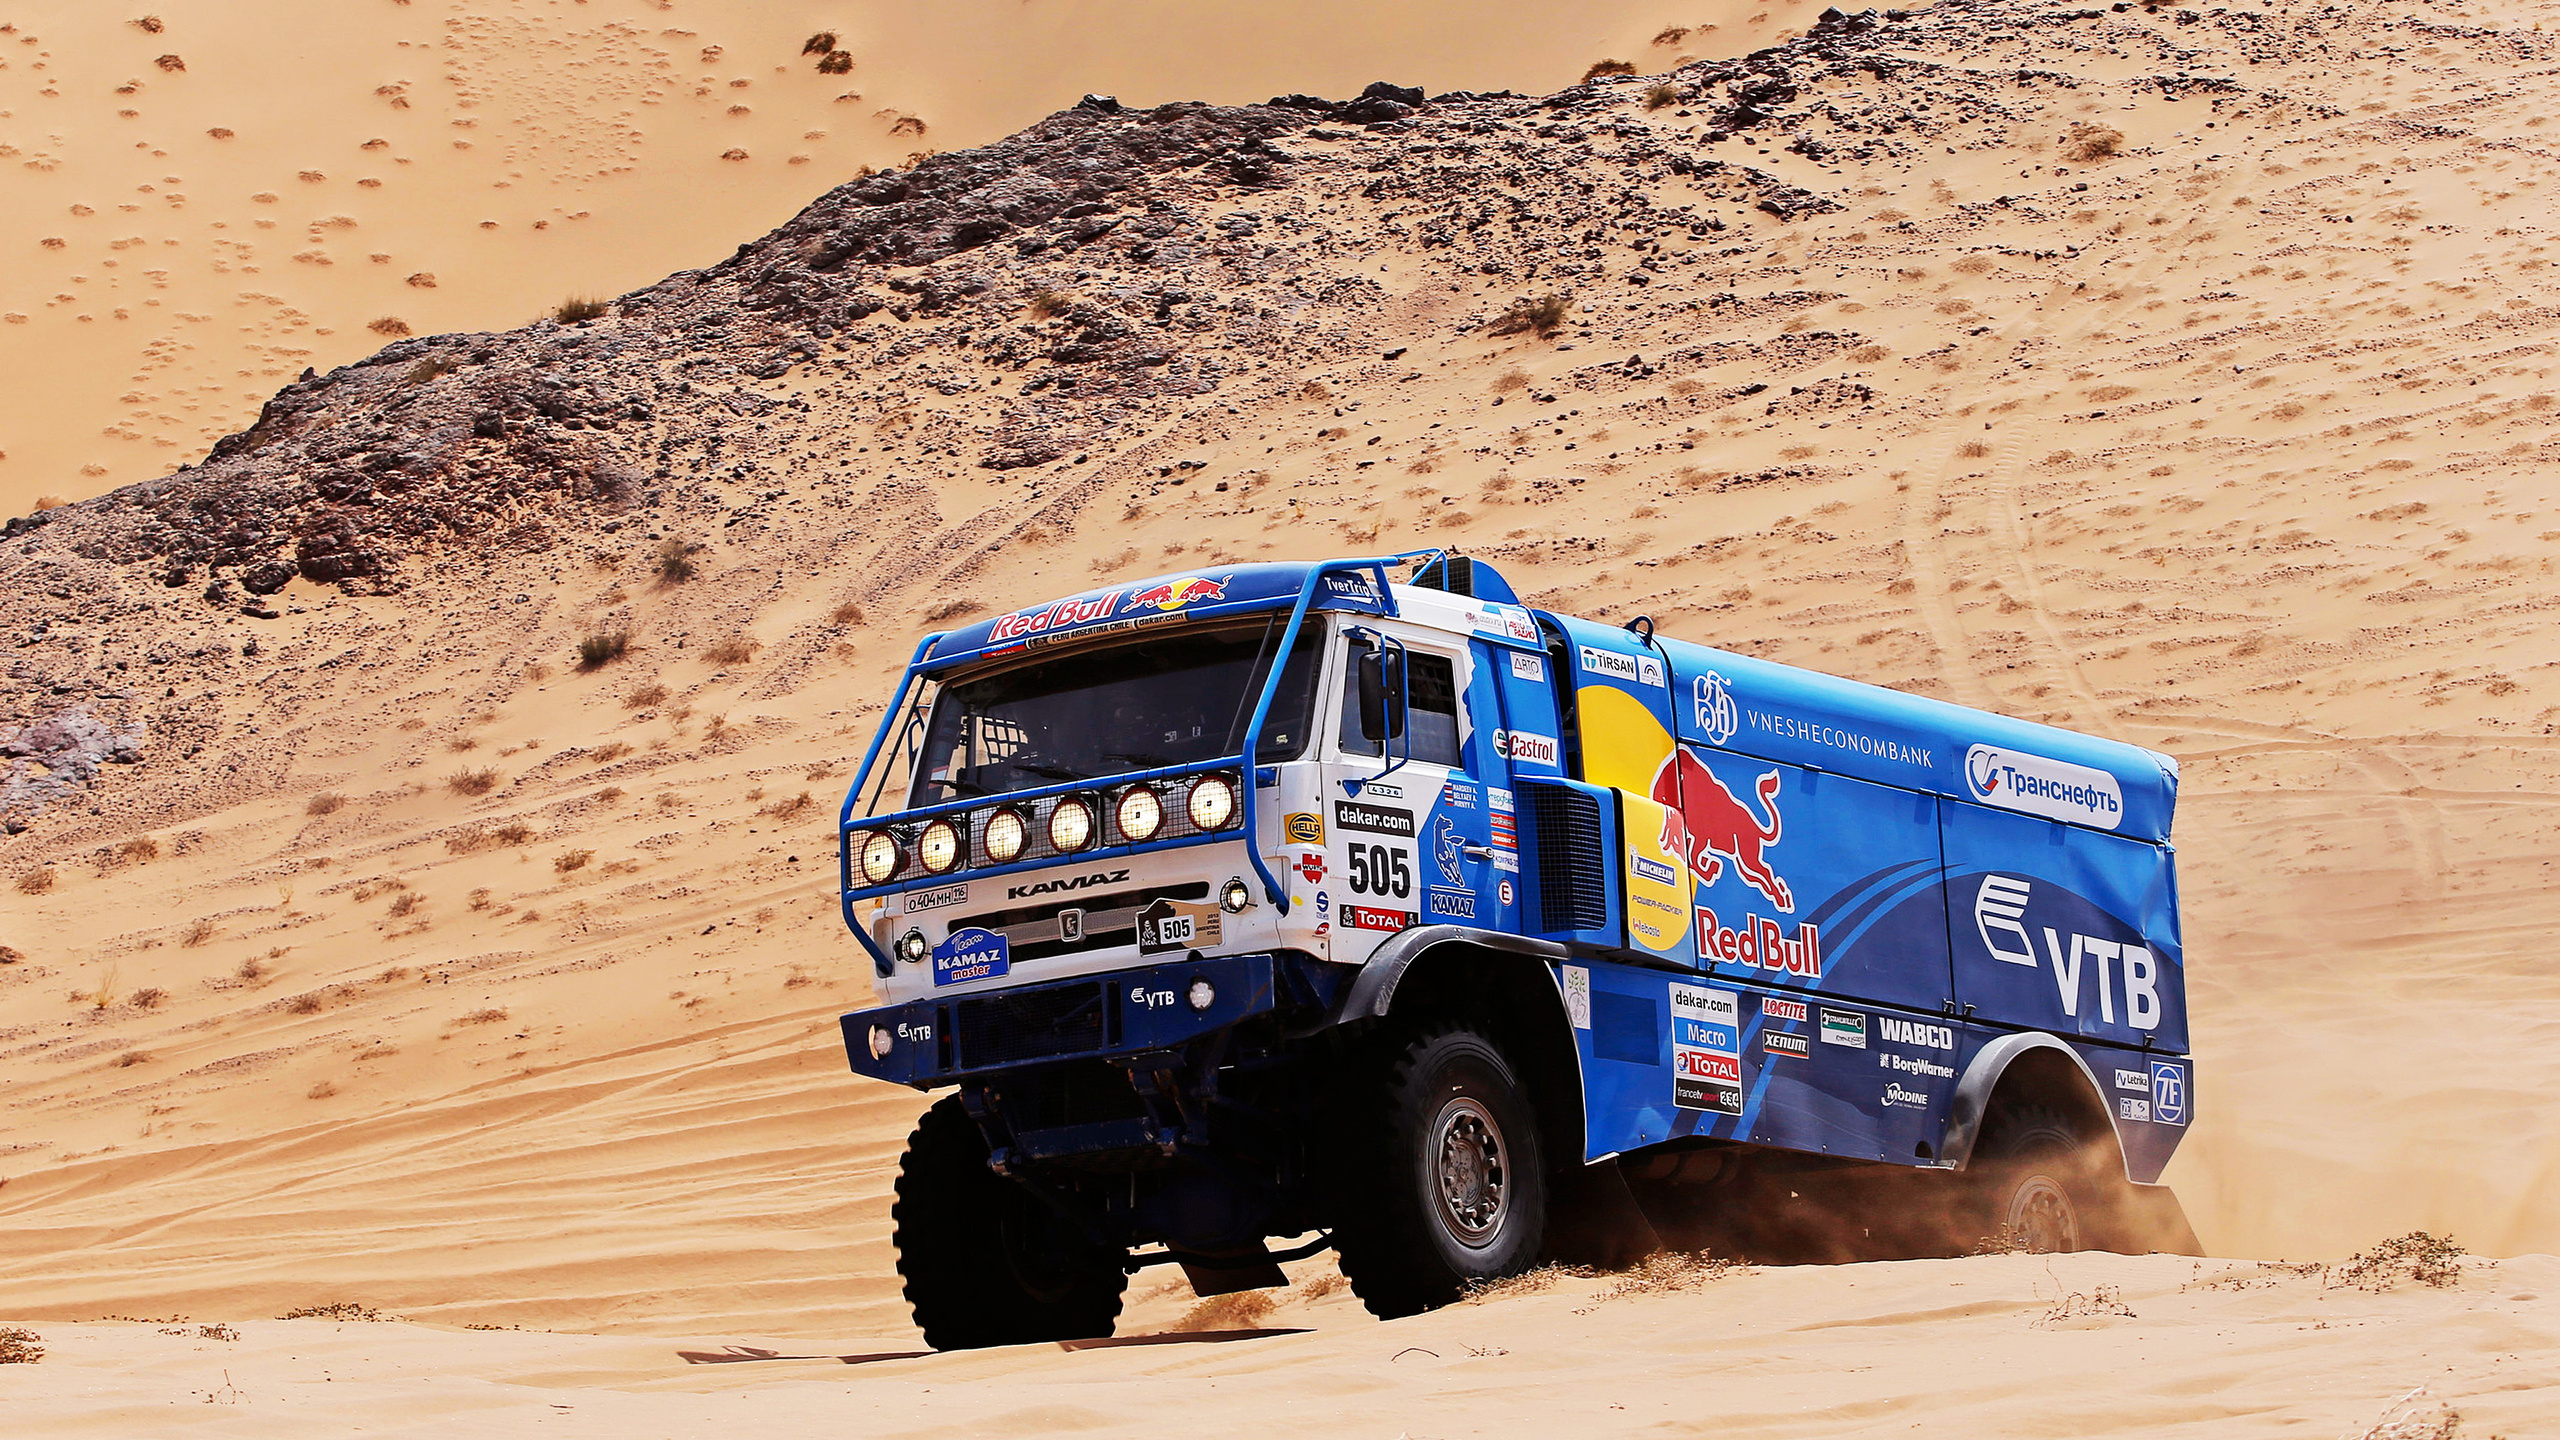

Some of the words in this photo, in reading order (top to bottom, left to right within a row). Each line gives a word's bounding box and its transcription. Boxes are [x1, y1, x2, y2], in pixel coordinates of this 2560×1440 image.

[1324, 577, 1370, 597] TverTrip
[987, 603, 1059, 643] Red
[1051, 589, 1125, 628] Bull
[1139, 613, 1184, 626] dakar.com
[1510, 734, 1554, 762] Castrol
[1747, 709, 1933, 769] VNESHECONOMBANK
[2002, 765, 2118, 813] Транснефть
[1292, 822, 1320, 834] HELLA
[1339, 806, 1410, 830] dakar.com
[1348, 842, 1410, 899] 505
[1640, 861, 1674, 880] MICHELIN
[1007, 869, 1130, 900] KAMAZ
[1431, 893, 1475, 918] KAMAZ
[1163, 919, 1191, 940] 505
[1357, 910, 1404, 929] TOTAL
[951, 933, 984, 953] Team
[1695, 905, 1761, 969] Red
[1759, 917, 1822, 979] Bull
[938, 949, 1001, 971] KAMAZ
[952, 965, 990, 980] master
[2042, 927, 2161, 1031] VTB
[1146, 991, 1175, 1010] VTB
[1675, 990, 1732, 1014] dakar.com
[1763, 999, 1806, 1020] LOCTITE
[1687, 1023, 1726, 1047] Macro
[1878, 1016, 1953, 1050] WABCO
[1690, 1053, 1738, 1079] TOTAL
[1892, 1054, 1954, 1079] BorgWarner
[2127, 1074, 2148, 1086] Letrika
[1887, 1089, 1928, 1105] MODINE
[2156, 1077, 2181, 1111] ZF
